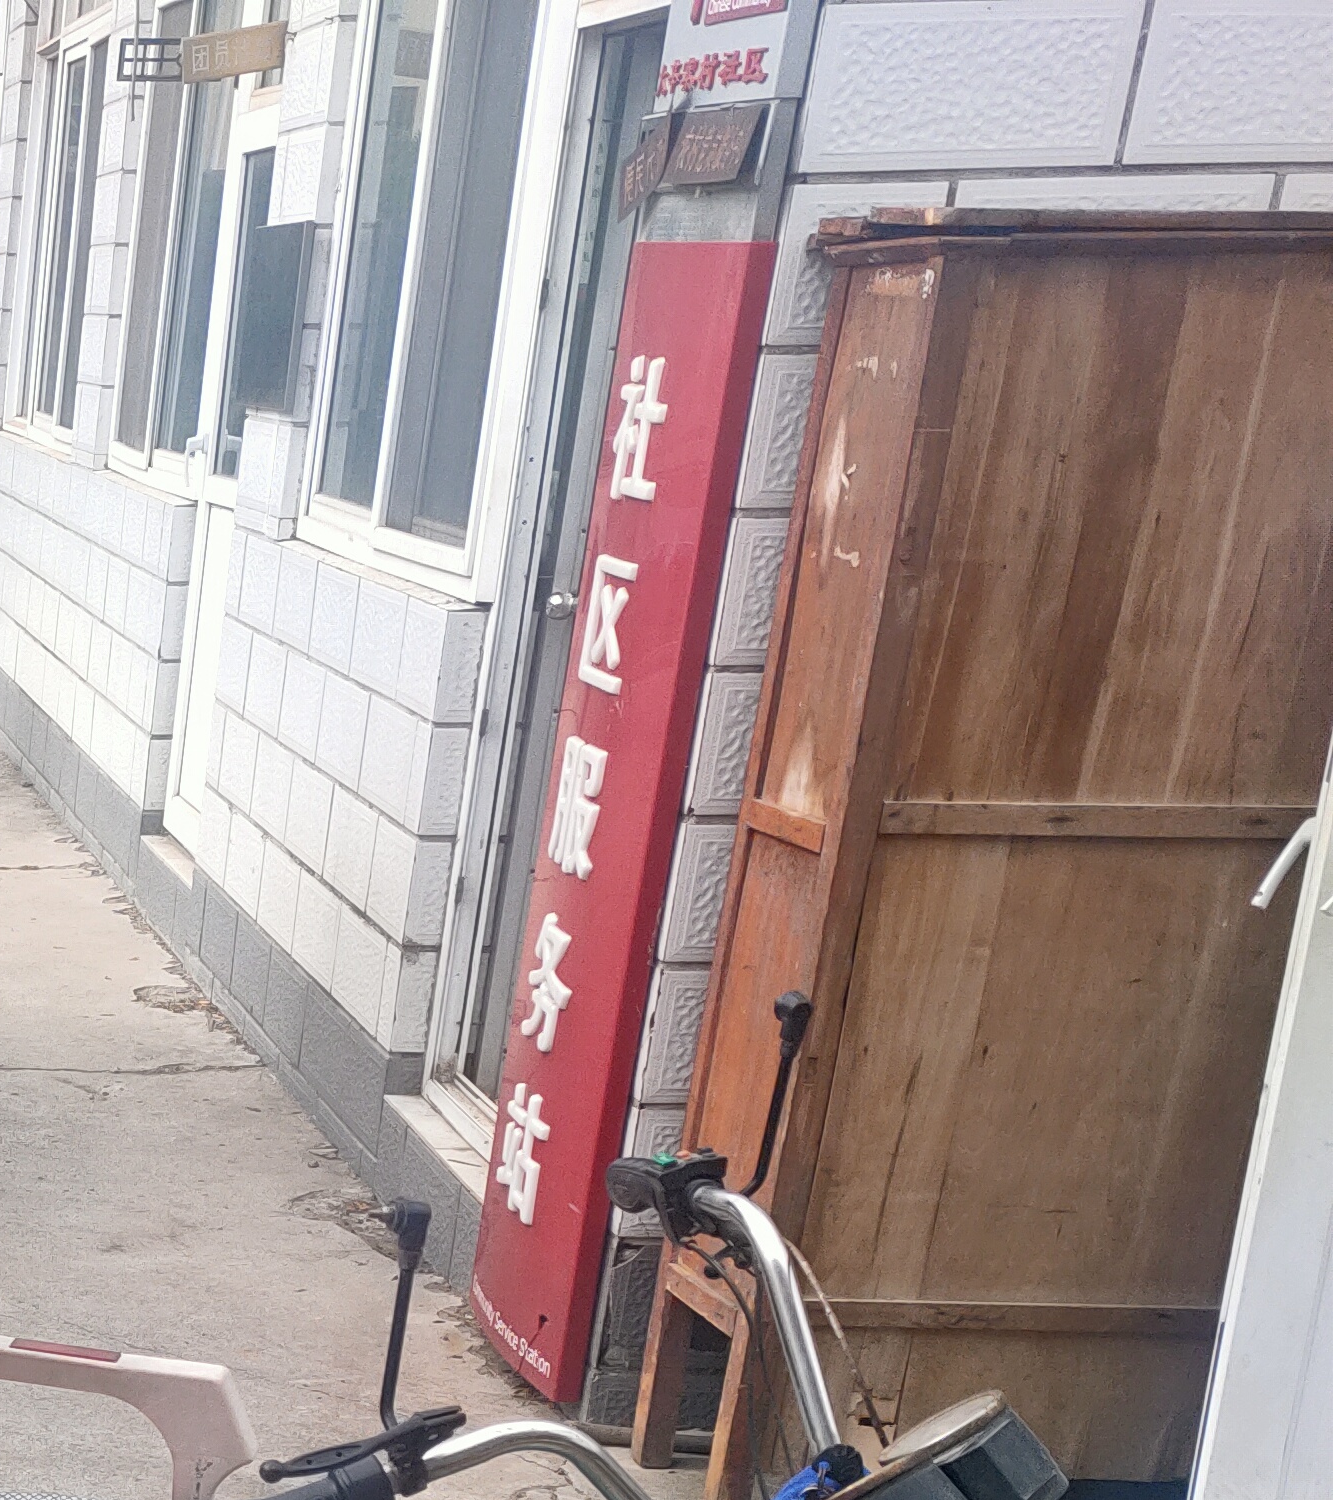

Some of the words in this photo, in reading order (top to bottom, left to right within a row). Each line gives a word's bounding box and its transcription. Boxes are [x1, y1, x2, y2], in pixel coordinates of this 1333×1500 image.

[496, 354, 668, 1226] 社区服务站
[518, 1338, 551, 1379] Station
